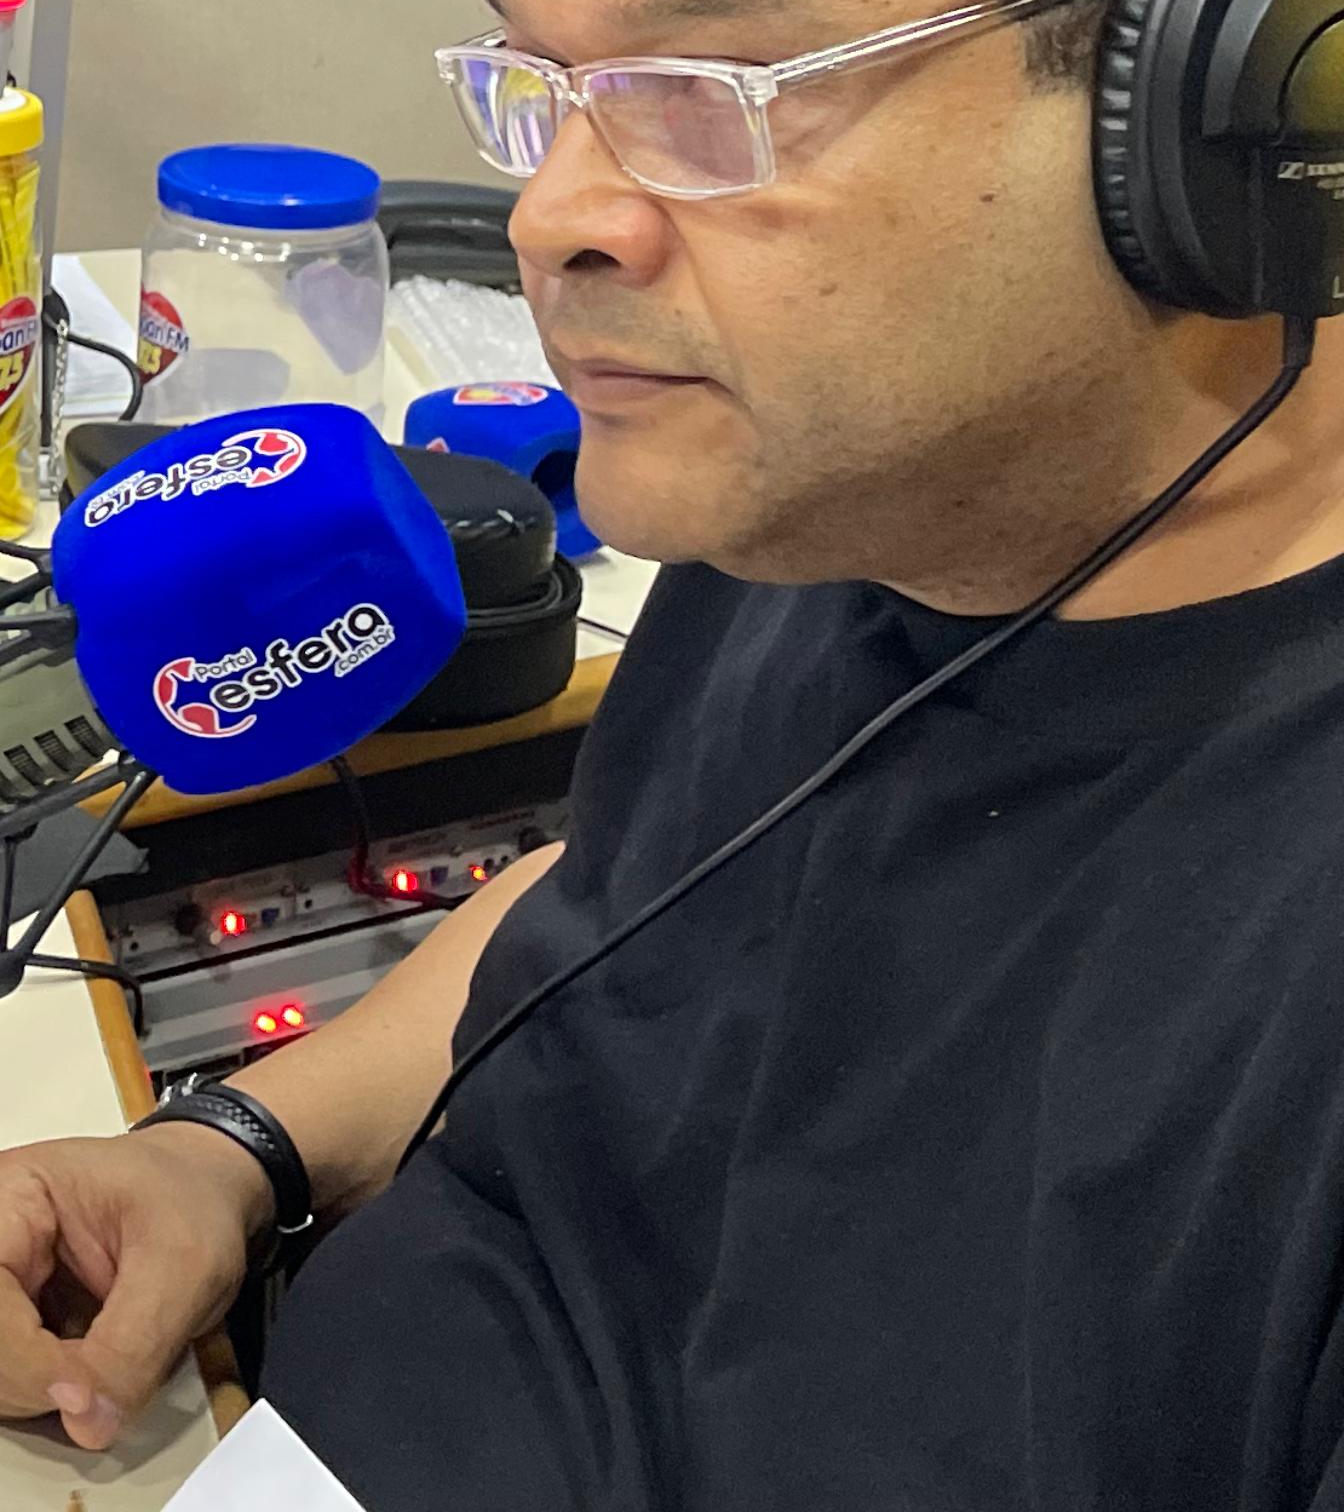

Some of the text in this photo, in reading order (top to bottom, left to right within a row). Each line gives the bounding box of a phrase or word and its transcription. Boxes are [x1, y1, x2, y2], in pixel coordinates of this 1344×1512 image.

[87, 448, 249, 526] esfera
[194, 649, 256, 680] Portal
[213, 606, 387, 710] esfera
[334, 625, 395, 676] .com.br
